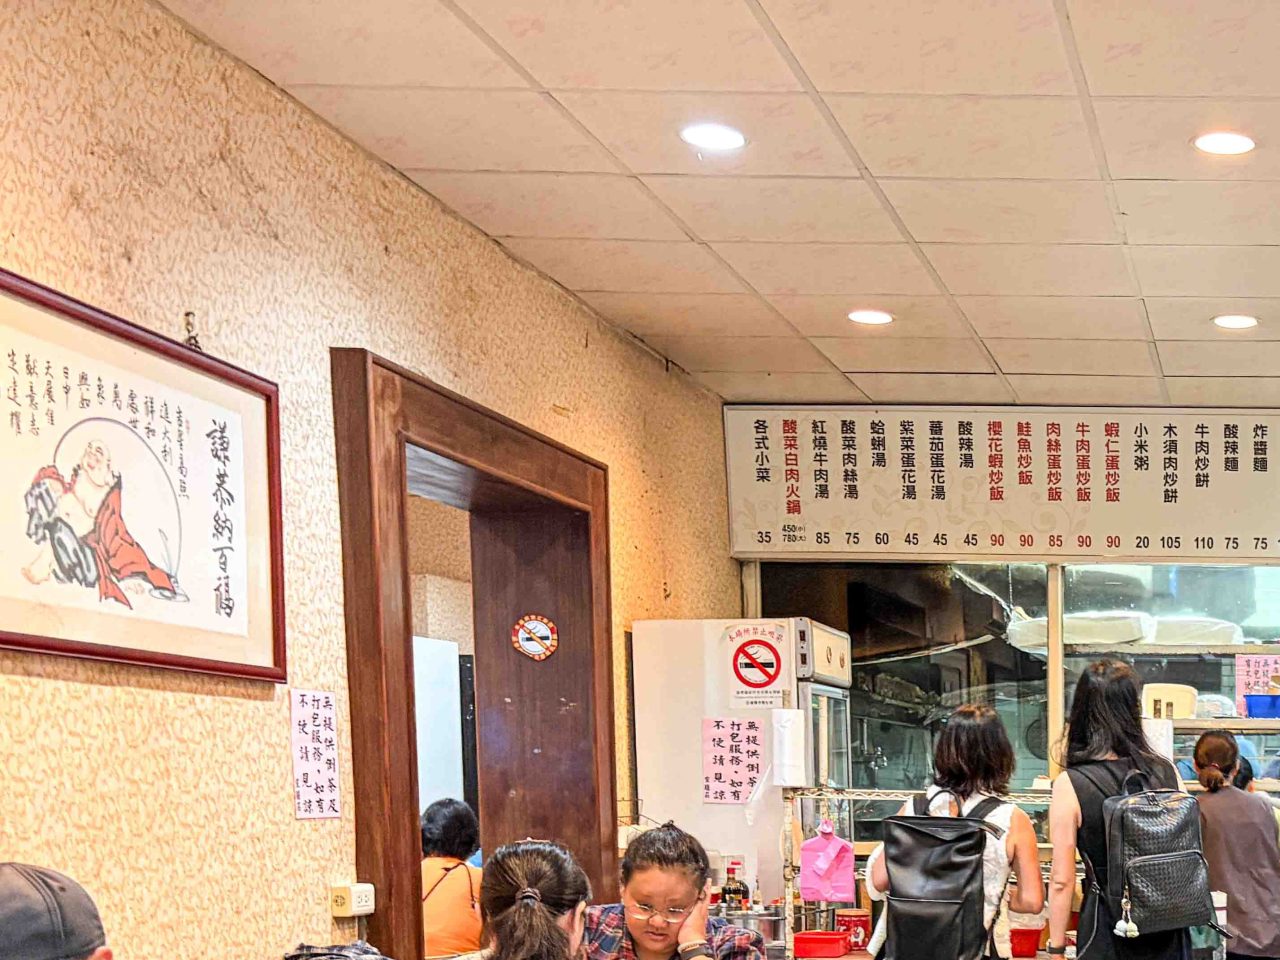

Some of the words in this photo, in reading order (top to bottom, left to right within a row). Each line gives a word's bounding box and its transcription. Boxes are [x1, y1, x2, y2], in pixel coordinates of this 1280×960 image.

[754, 420, 771, 482] 各式小菜
[782, 419, 801, 514] 酸菜白肉火鍋
[812, 420, 829, 499] 紅燒牛肉湯
[841, 420, 858, 499] 酸菜肉絲湯
[870, 420, 886, 467] 蛤蜊湯
[900, 421, 916, 499] 紫菜蛋花湯
[929, 421, 945, 500] 蕃茄蛋花湯
[958, 421, 974, 468] 酸辣湯
[988, 421, 1004, 501] 櫻花蝦炒飯
[1017, 422, 1032, 485] 鮭魚炒飯
[1047, 423, 1062, 501] 肉絲蛋炒飯
[1076, 423, 1091, 501] 牛肉蛋炒飯
[1105, 422, 1120, 502] 蝦仁蛋炒飯
[1134, 423, 1149, 471] 小米粥
[1163, 424, 1178, 503] 木須肉炒餅
[1195, 424, 1210, 488] 牛肉炒餅
[1224, 424, 1238, 471] 酸辣麵
[1253, 424, 1268, 472] 炸醬麵
[757, 532, 771, 543] 35
[816, 532, 830, 544] 85
[845, 532, 859, 544] 75
[875, 533, 889, 545] 60
[905, 533, 919, 545] 45
[933, 533, 947, 545] 45
[964, 533, 977, 546] 45
[991, 534, 1004, 546] 90
[1020, 534, 1033, 547] 90
[1049, 535, 1062, 547] 85
[1078, 535, 1091, 548] 90
[1106, 535, 1120, 548] 90
[1136, 536, 1149, 548] 20
[1160, 536, 1180, 549] 105
[1194, 537, 1213, 549] 110
[1225, 537, 1238, 549] 75
[1254, 537, 1268, 549] 75
[745, 721, 760, 800] 無提供倒茶
